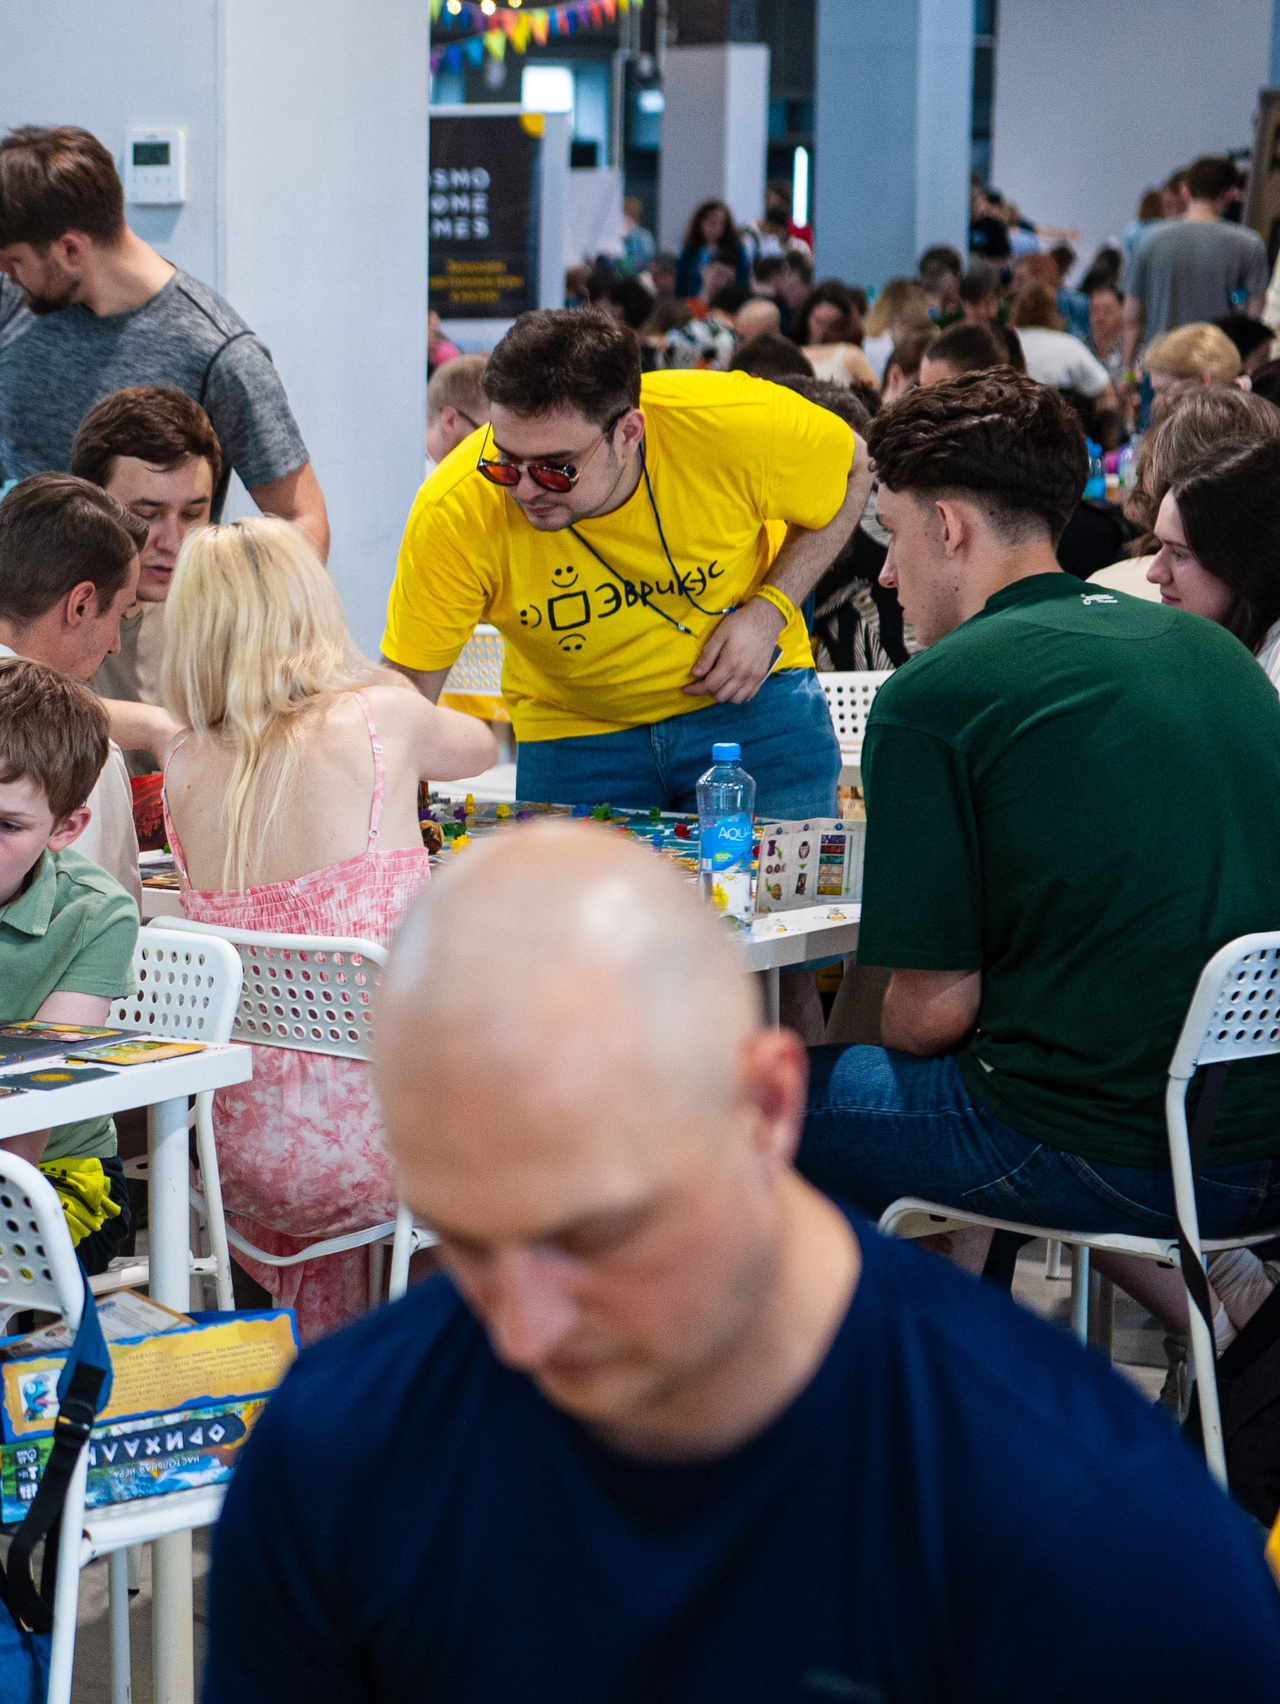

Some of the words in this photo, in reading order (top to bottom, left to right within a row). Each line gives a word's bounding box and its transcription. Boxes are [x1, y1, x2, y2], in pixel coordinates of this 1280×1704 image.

[429, 167, 490, 190] SMO
[594, 560, 725, 619] Эврикус
[112, 1466, 136, 1479] ИГРА
[139, 1454, 200, 1474] НАСТОЛЬНАЯ
